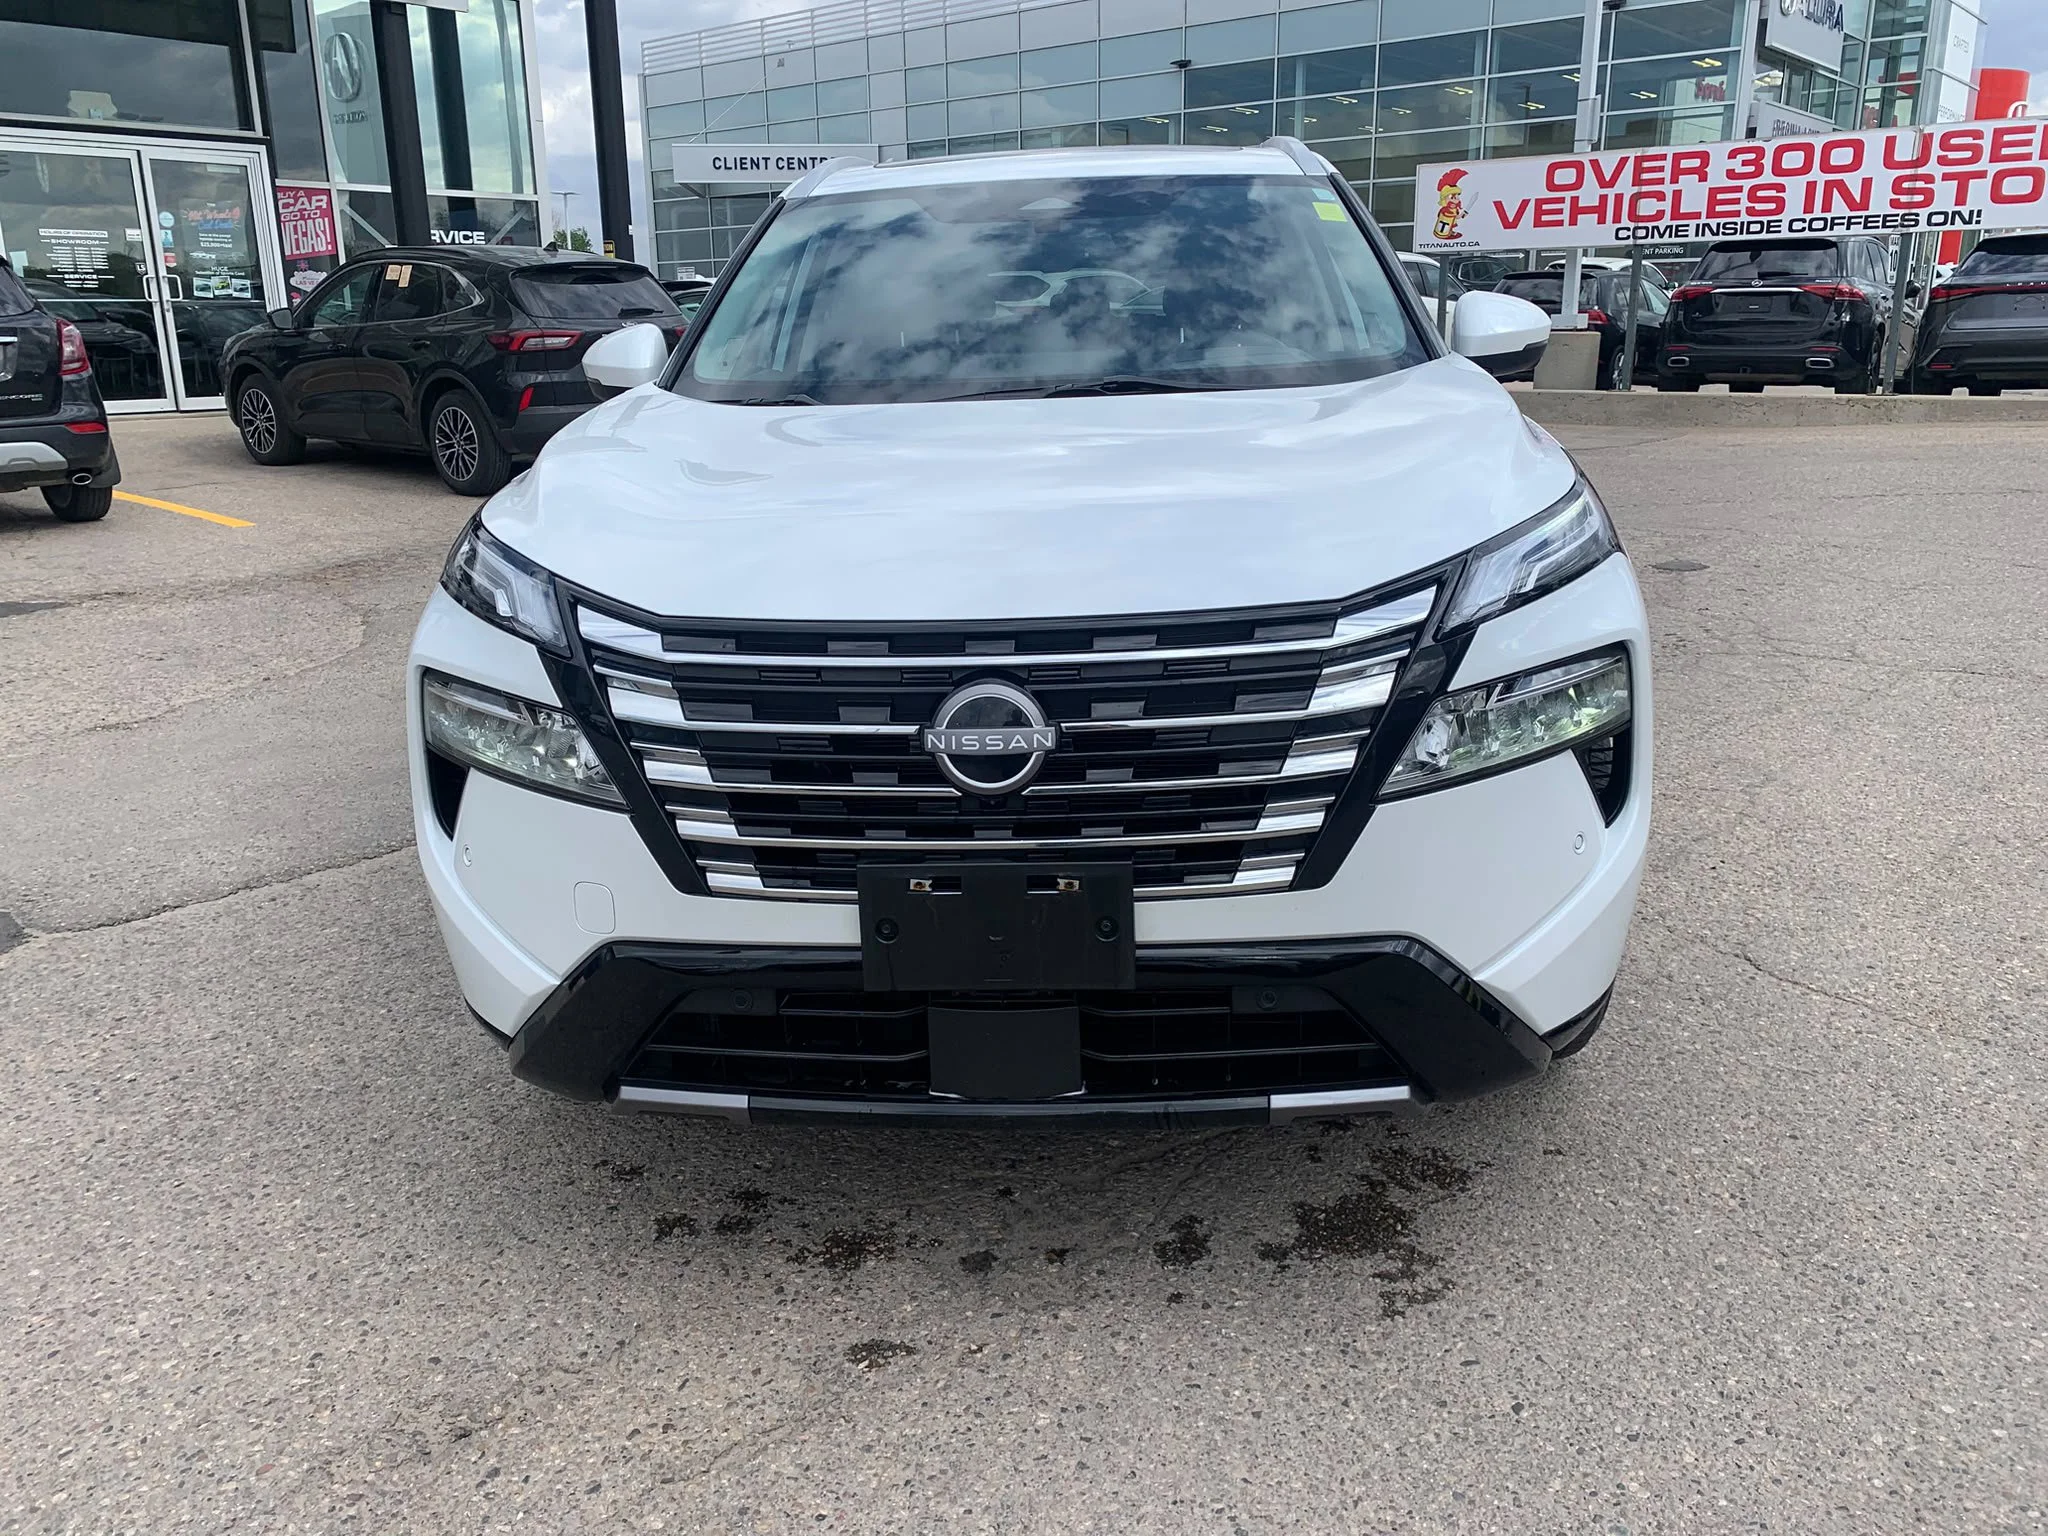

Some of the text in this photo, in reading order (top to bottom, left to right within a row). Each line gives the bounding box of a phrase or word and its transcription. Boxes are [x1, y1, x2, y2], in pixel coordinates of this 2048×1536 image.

[712, 156, 836, 170] CLIENT CENT
[1545, 150, 1711, 193] OVER
[1725, 137, 1866, 181] 300
[278, 195, 328, 213] CAR
[1492, 166, 2047, 230] VEHICLES IN STO
[281, 210, 321, 221] GO TO
[1614, 209, 1982, 241] COME INSIDE COFFEES ON!
[280, 217, 332, 256] VEGAS!
[1438, 221, 1449, 234] T
[1418, 241, 1480, 249] TITANAUTO.CA
[1655, 246, 1684, 255] PARKING
[1890, 249, 1899, 272] 10
[927, 731, 1053, 751] NISSAN
